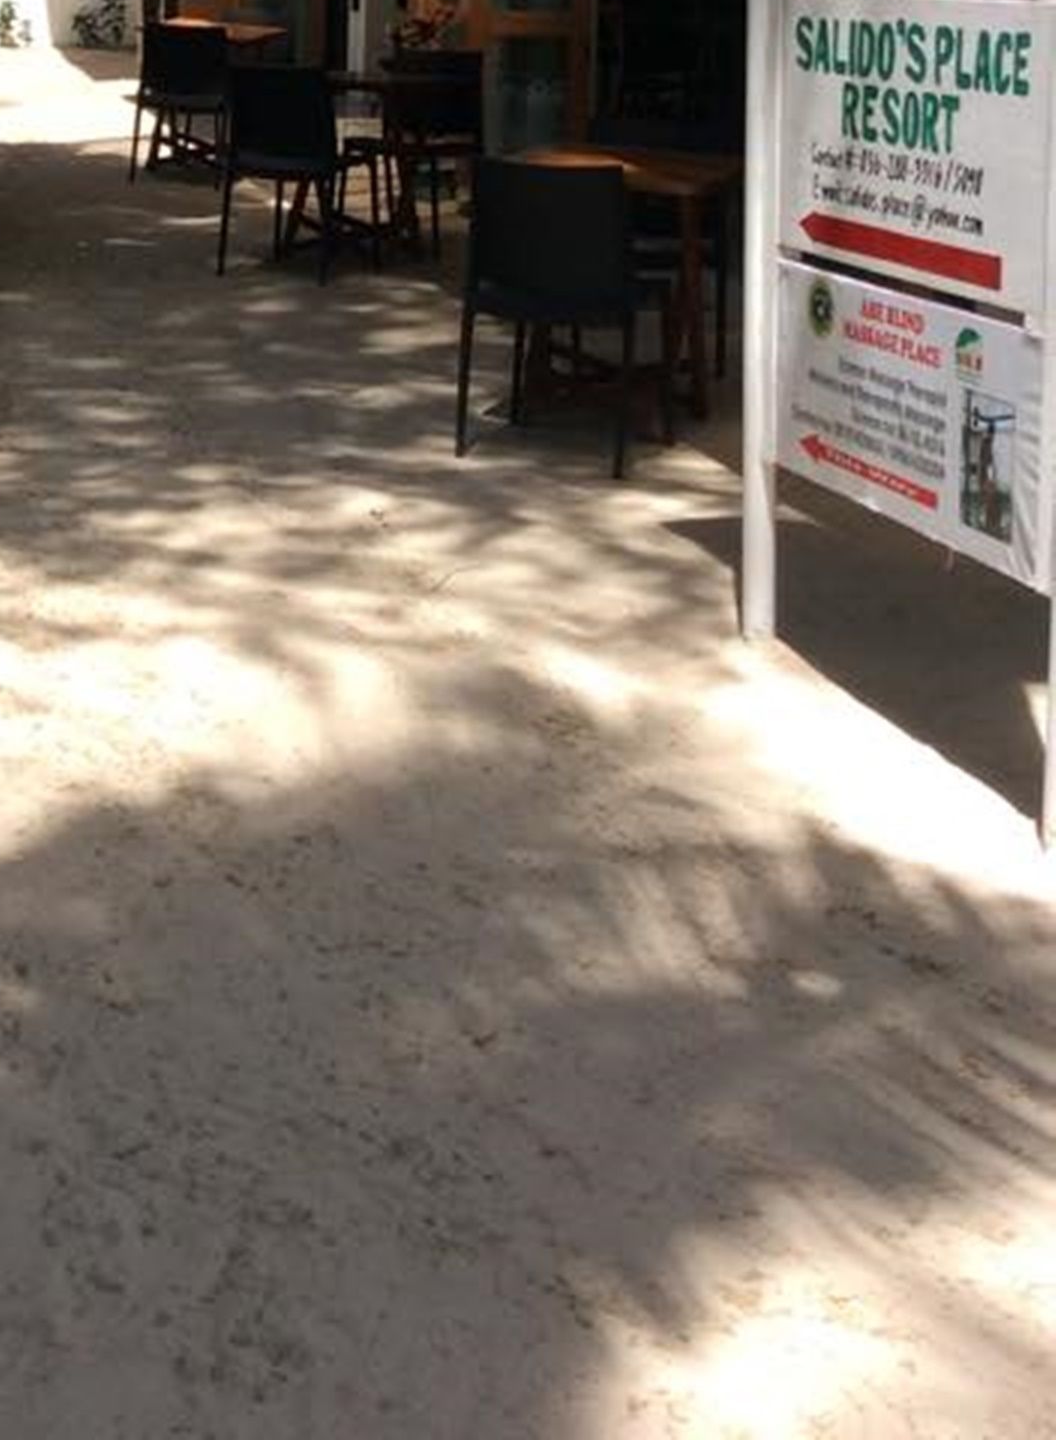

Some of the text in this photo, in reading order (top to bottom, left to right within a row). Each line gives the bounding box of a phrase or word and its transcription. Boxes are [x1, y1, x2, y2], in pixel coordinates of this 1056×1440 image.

[795, 16, 1032, 96] SALIDO'S PLACE
[841, 83, 960, 154] RESORT
